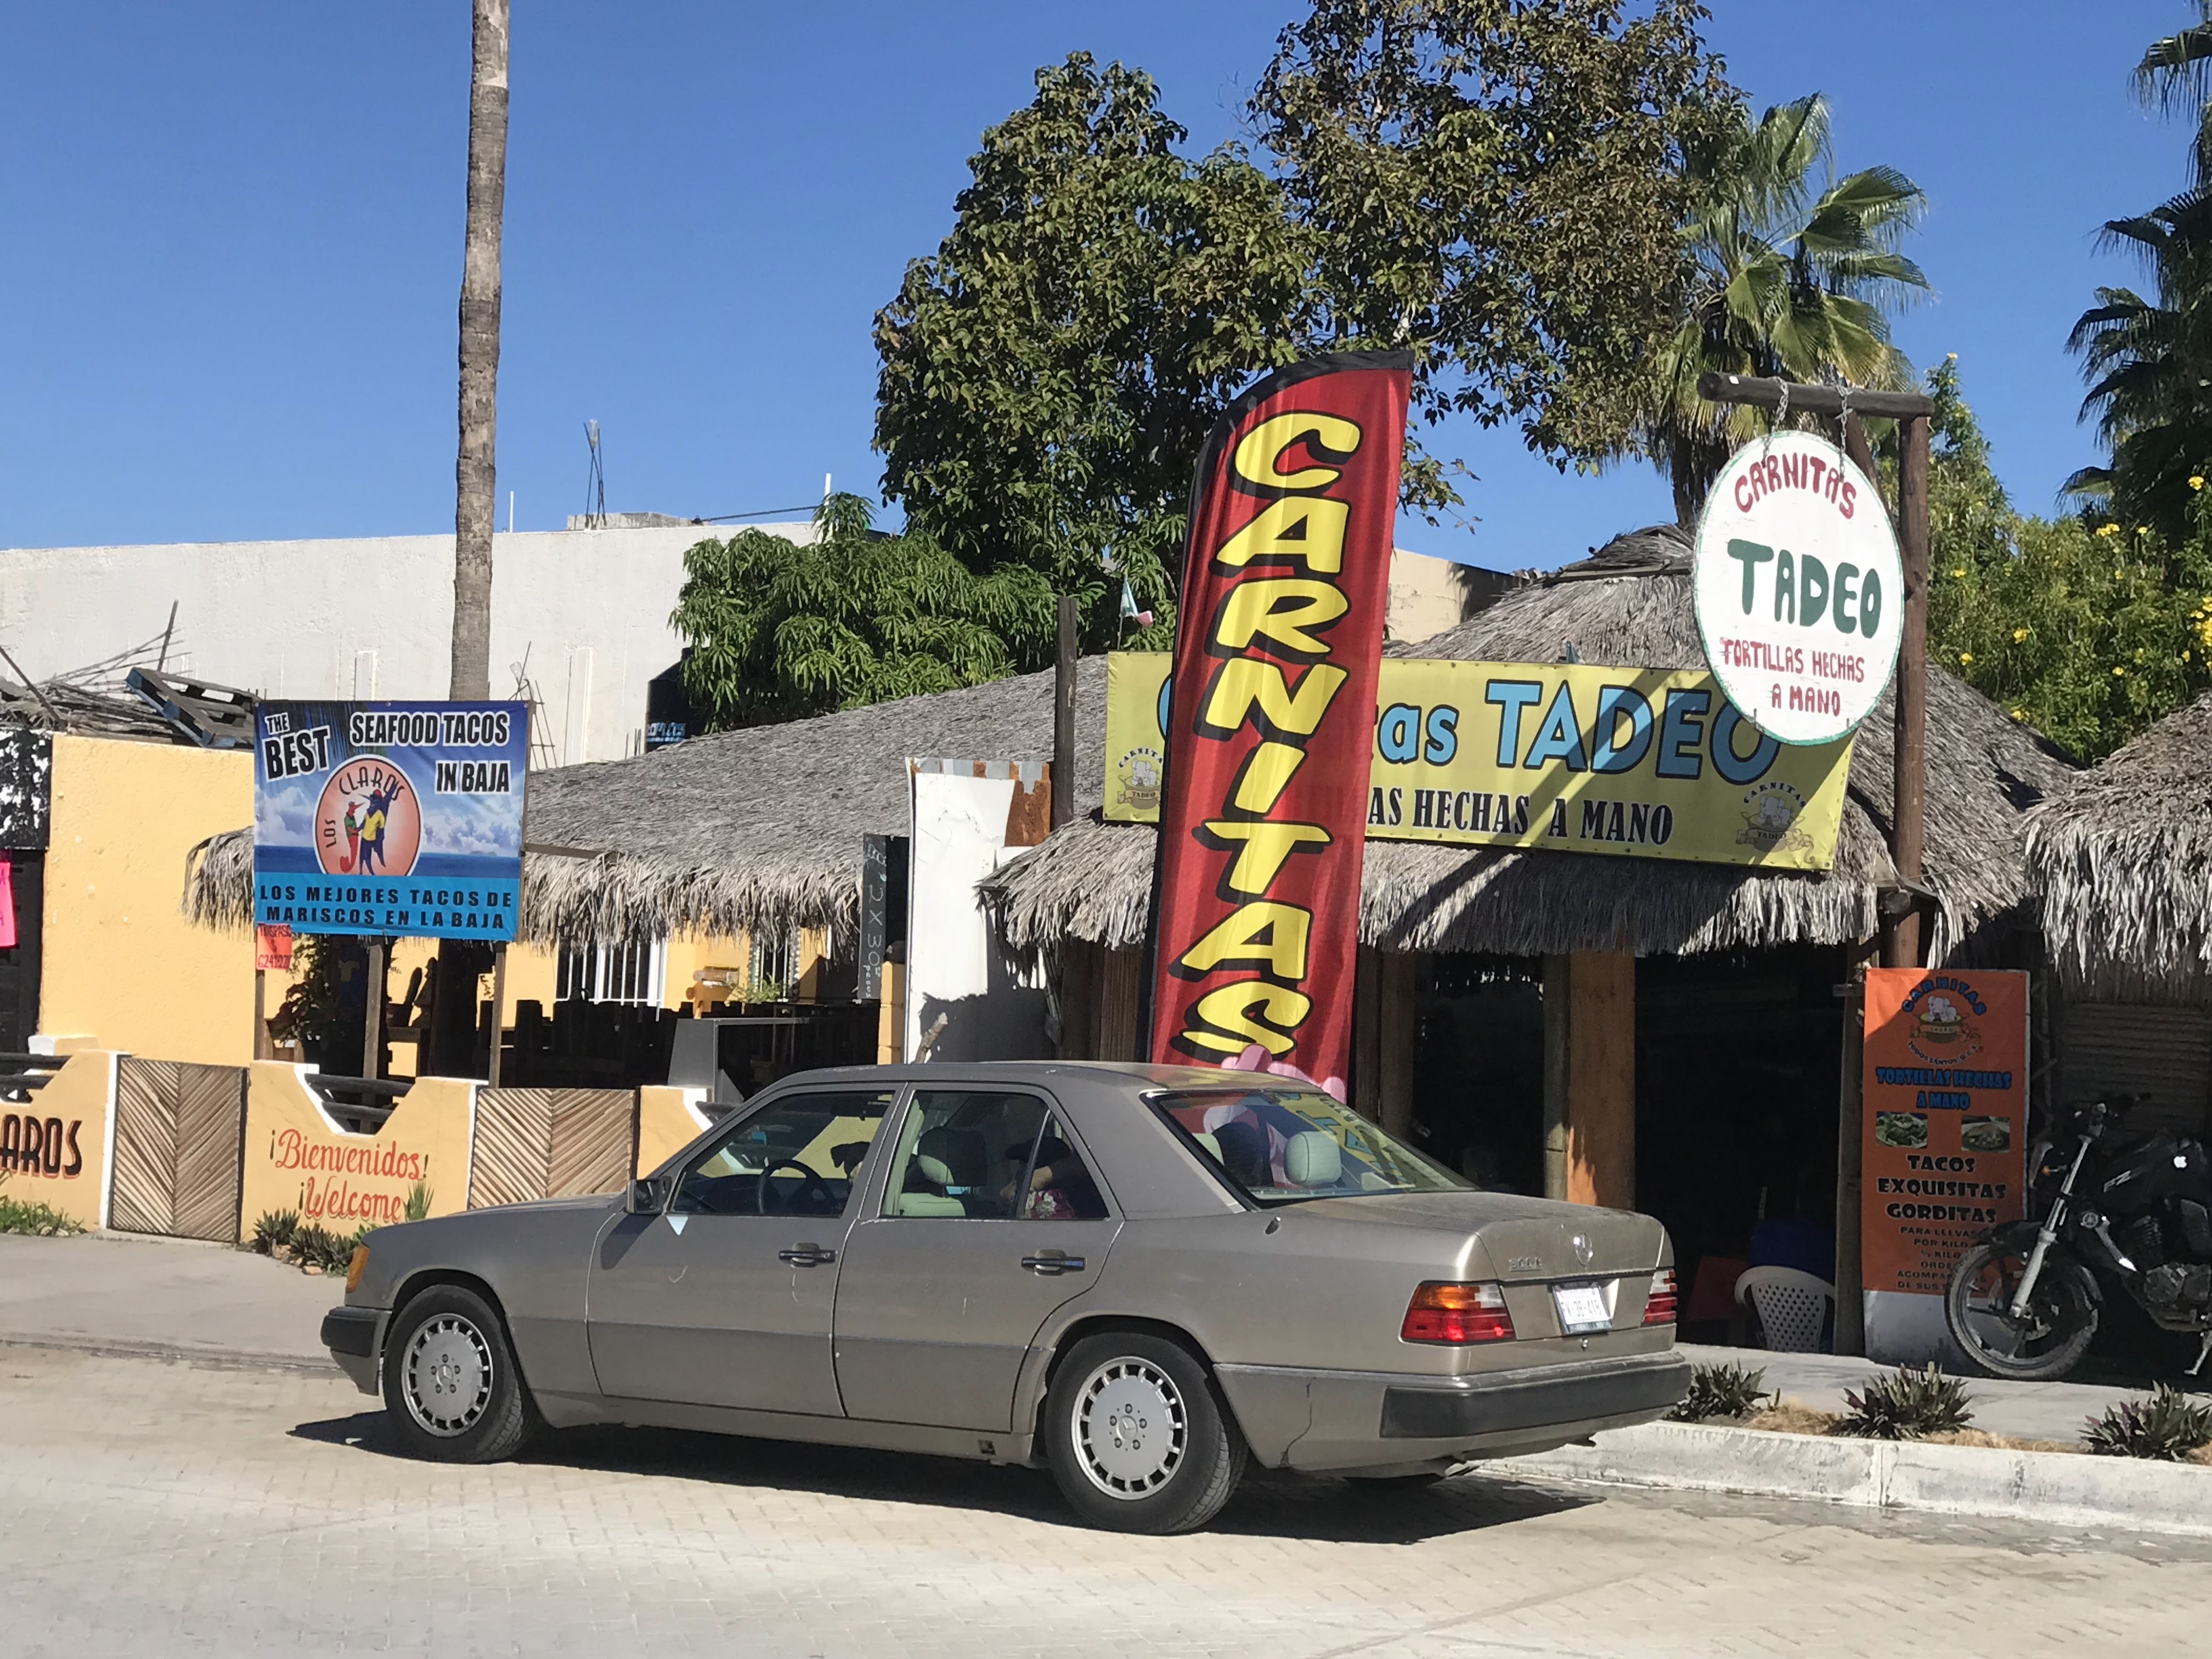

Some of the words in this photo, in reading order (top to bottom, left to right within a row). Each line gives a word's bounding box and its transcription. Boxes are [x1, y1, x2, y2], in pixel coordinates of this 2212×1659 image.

[1735, 453, 1856, 519] CARNITAS
[1727, 539, 1881, 639] TADEO
[1720, 637, 1803, 674] TORTILLAS
[1812, 652, 1864, 682] HECHAS
[1772, 683, 1781, 708] A
[1790, 685, 1840, 716] MANO
[266, 714, 288, 733] THE
[352, 714, 438, 744] SEAFOOD
[443, 715, 508, 744] TACOS
[1170, 410, 1363, 1059] CARNITAS
[1486, 679, 1781, 786] TADEO
[265, 729, 329, 779] BEST
[1119, 748, 1163, 768] CARNITA
[339, 766, 405, 801] CLAROS
[437, 763, 456, 792] IN
[462, 763, 509, 793] BAJA
[1743, 782, 1807, 808] CARNITAS
[1412, 789, 1530, 835] HECHAS
[1548, 798, 1568, 838] A
[1581, 800, 1673, 845] MANO
[324, 819, 336, 848] LOS
[1757, 831, 1786, 839] TADEO
[260, 885, 295, 901] LOS
[306, 887, 399, 904] MEJORES
[410, 889, 479, 907] TACOS
[487, 892, 511, 907] DE
[267, 906, 375, 925] MARISCOS
[386, 910, 409, 926] EN
[421, 911, 444, 927] LA
[452, 913, 504, 929] BAJA
[862, 965, 871, 998] pesos
[1902, 977, 1987, 1015] CARNITAS
[1908, 1041, 1928, 1060] TODOS
[1876, 1067, 1951, 1086] TORTILLAS
[1953, 1070, 2012, 1090] HECHAS
[1916, 1091, 1927, 1108] A
[1929, 1092, 1970, 1110] MANO
[1907, 1155, 1975, 1172] TACOS
[1877, 1178, 2006, 1199] EXQUISITAS
[1886, 1203, 1996, 1223] GORDITAS
